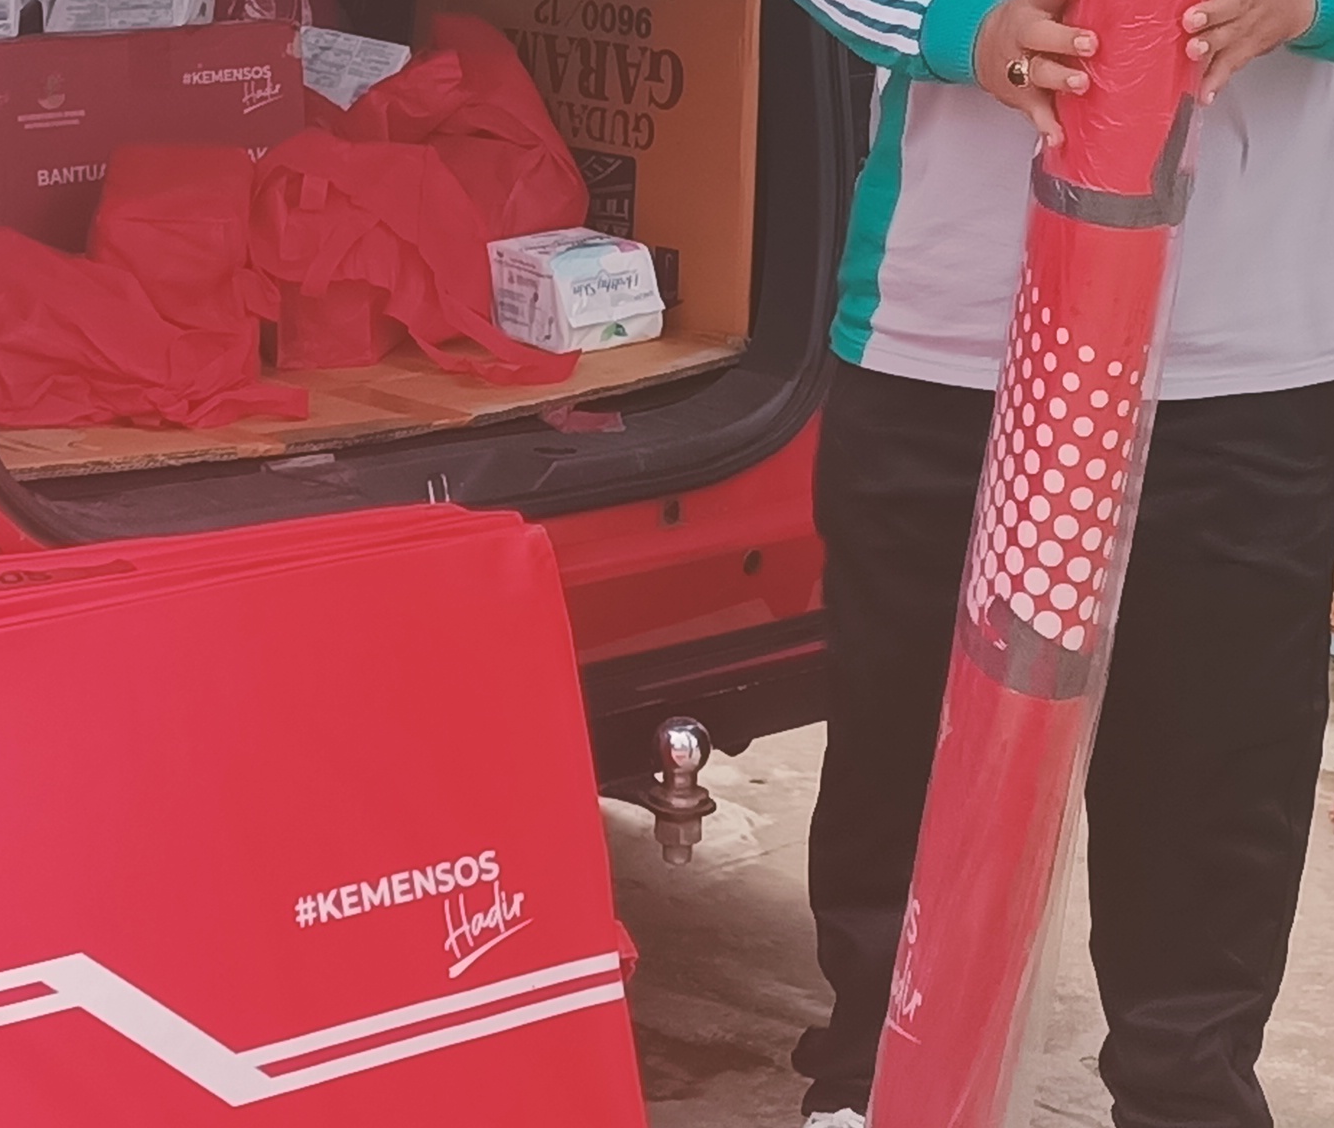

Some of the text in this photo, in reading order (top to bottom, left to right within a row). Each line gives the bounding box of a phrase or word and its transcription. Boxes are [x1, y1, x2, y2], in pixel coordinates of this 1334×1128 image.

[182, 65, 272, 85] #KEMENSOS
[295, 850, 500, 928] #KEMENSOS
[443, 880, 526, 959] Hadir
